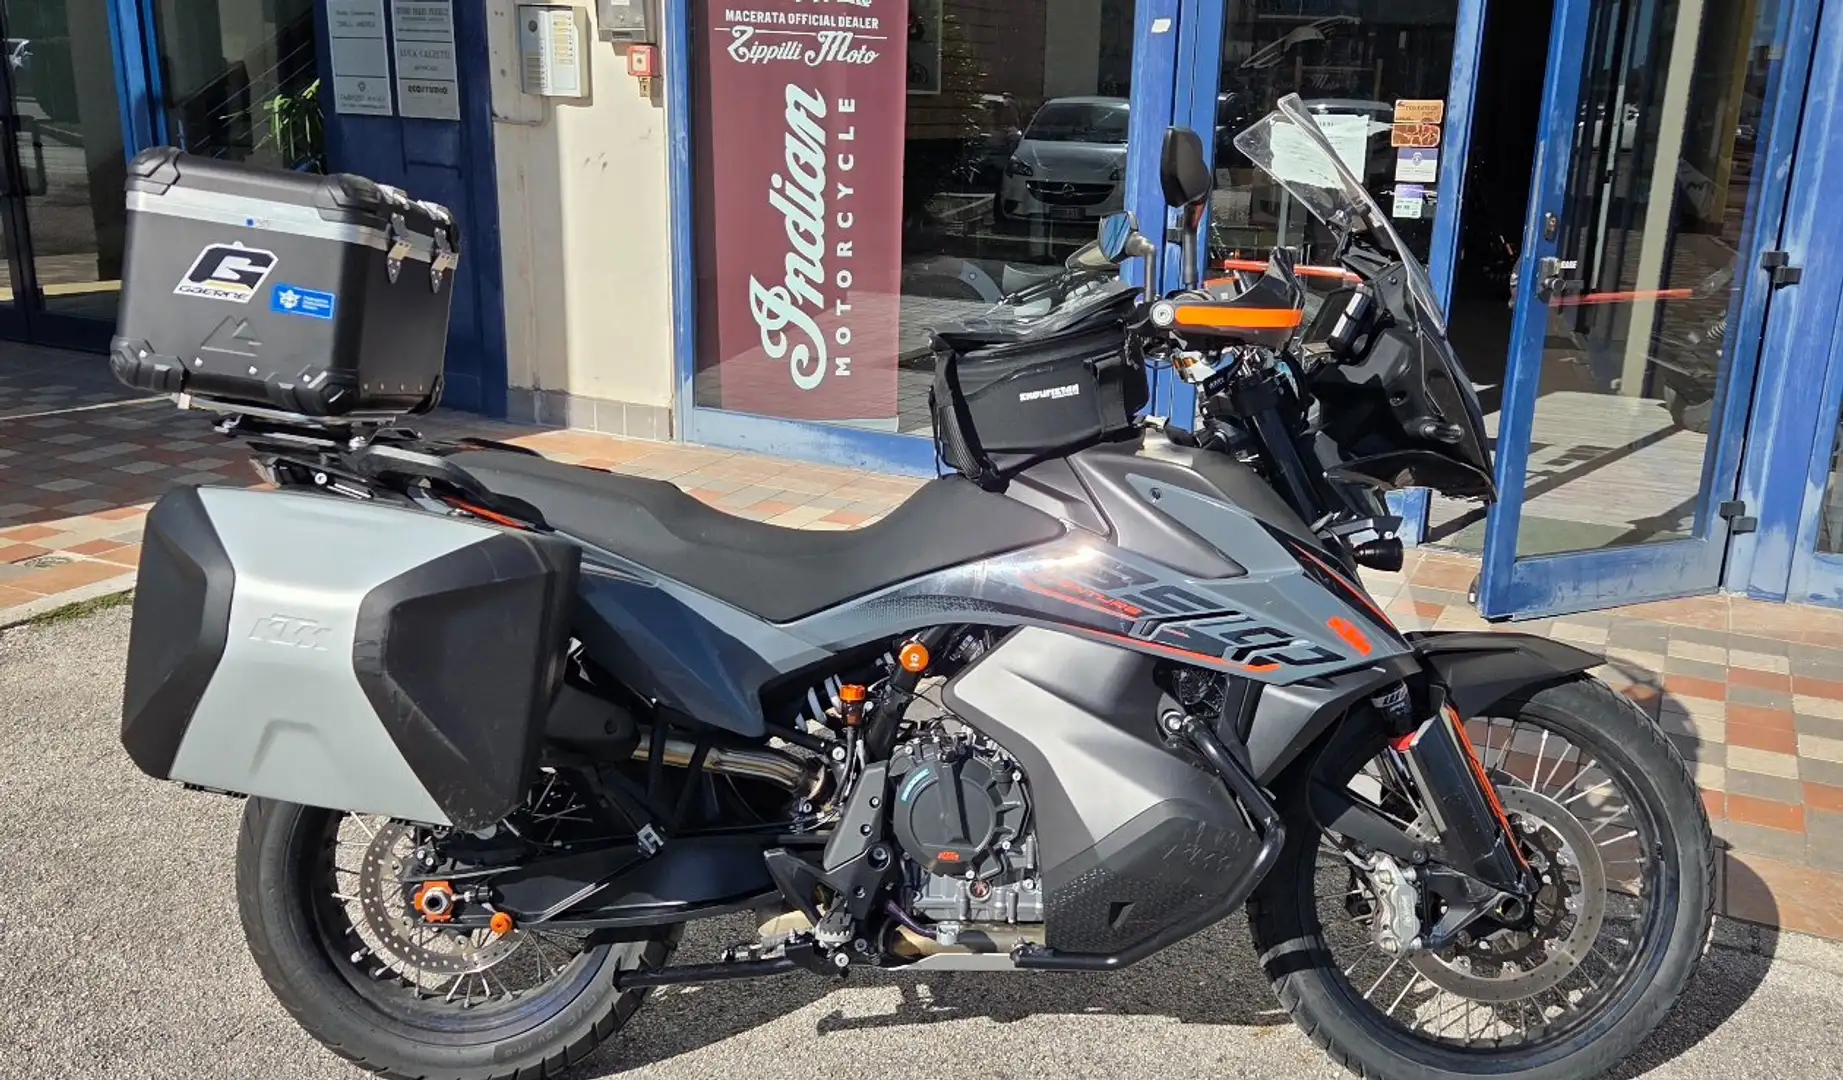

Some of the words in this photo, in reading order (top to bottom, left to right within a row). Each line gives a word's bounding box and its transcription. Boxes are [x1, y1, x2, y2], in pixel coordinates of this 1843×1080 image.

[725, 9, 786, 25] MACERATA
[788, 13, 836, 27] OFFICIAL
[838, 16, 879, 30] DEALER
[727, 25, 802, 65] Zippilli
[804, 30, 881, 67] Moto
[750, 83, 828, 390] Indian
[835, 98, 856, 376] MOTORCYCLE
